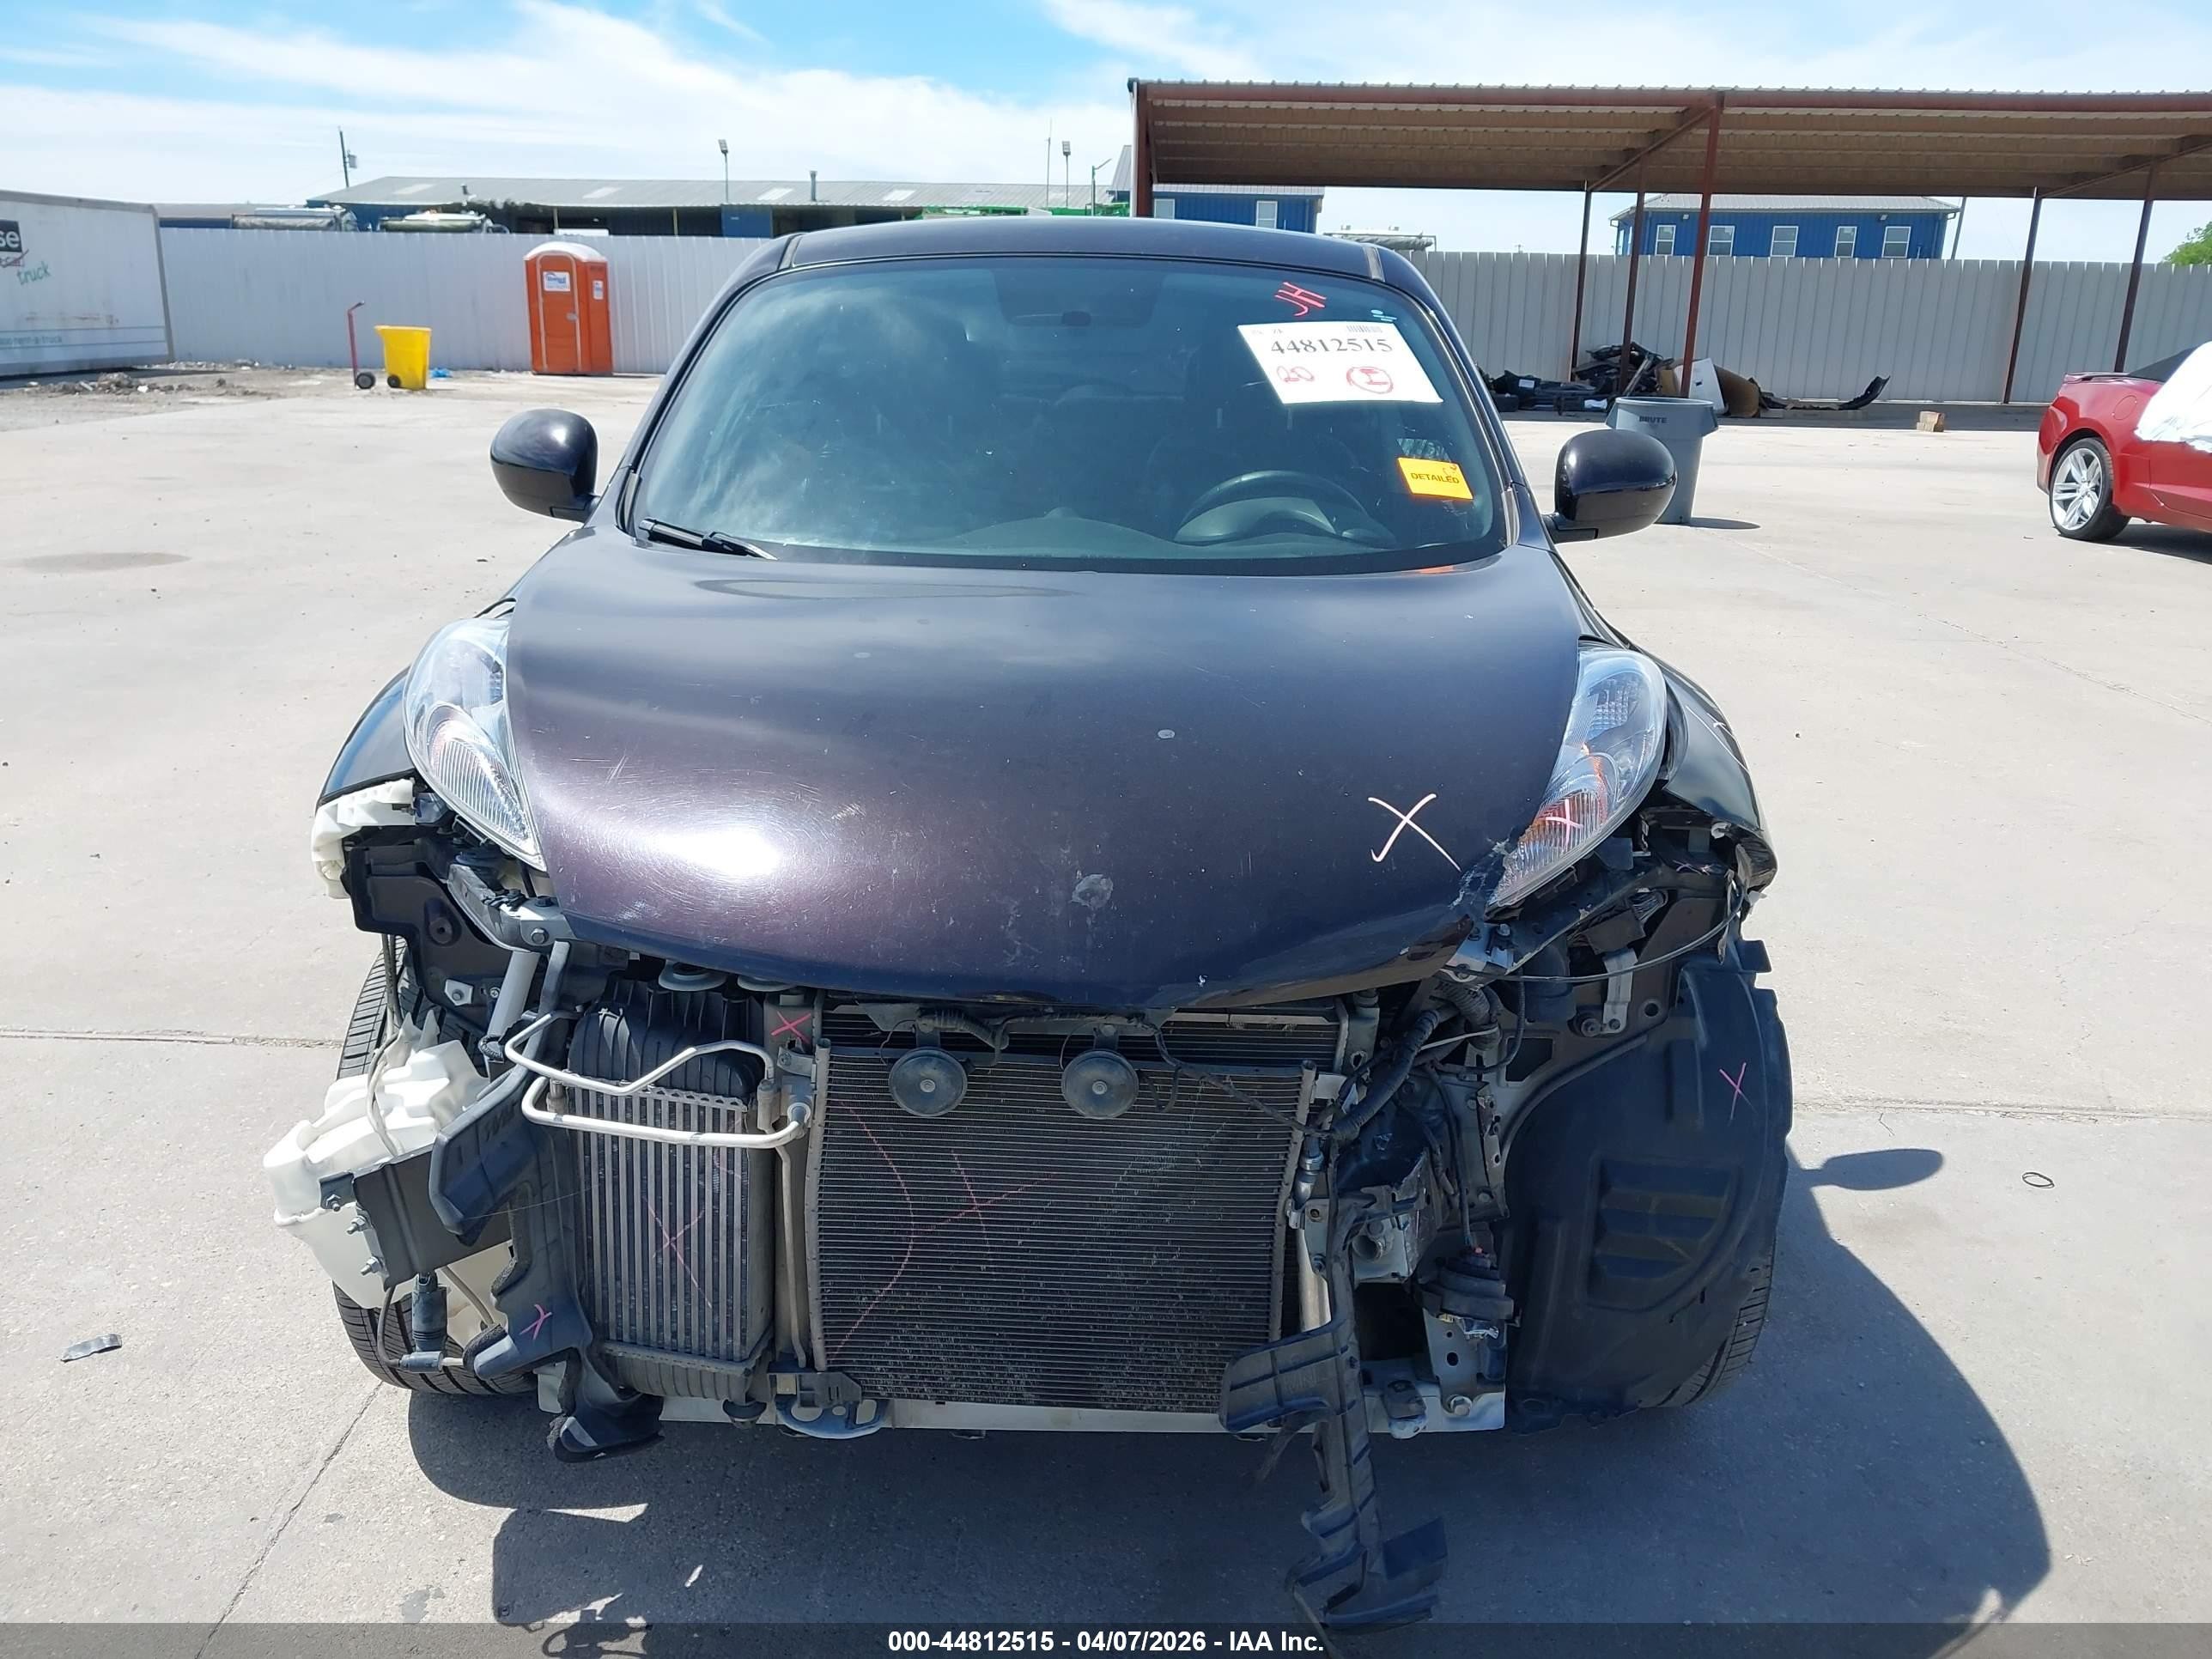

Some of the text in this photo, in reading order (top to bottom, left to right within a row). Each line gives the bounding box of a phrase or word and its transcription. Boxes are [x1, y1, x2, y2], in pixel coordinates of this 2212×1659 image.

[16, 261, 51, 285] truck
[1271, 338, 1393, 354] 44812515
[1410, 472, 1460, 483] DETAILED
